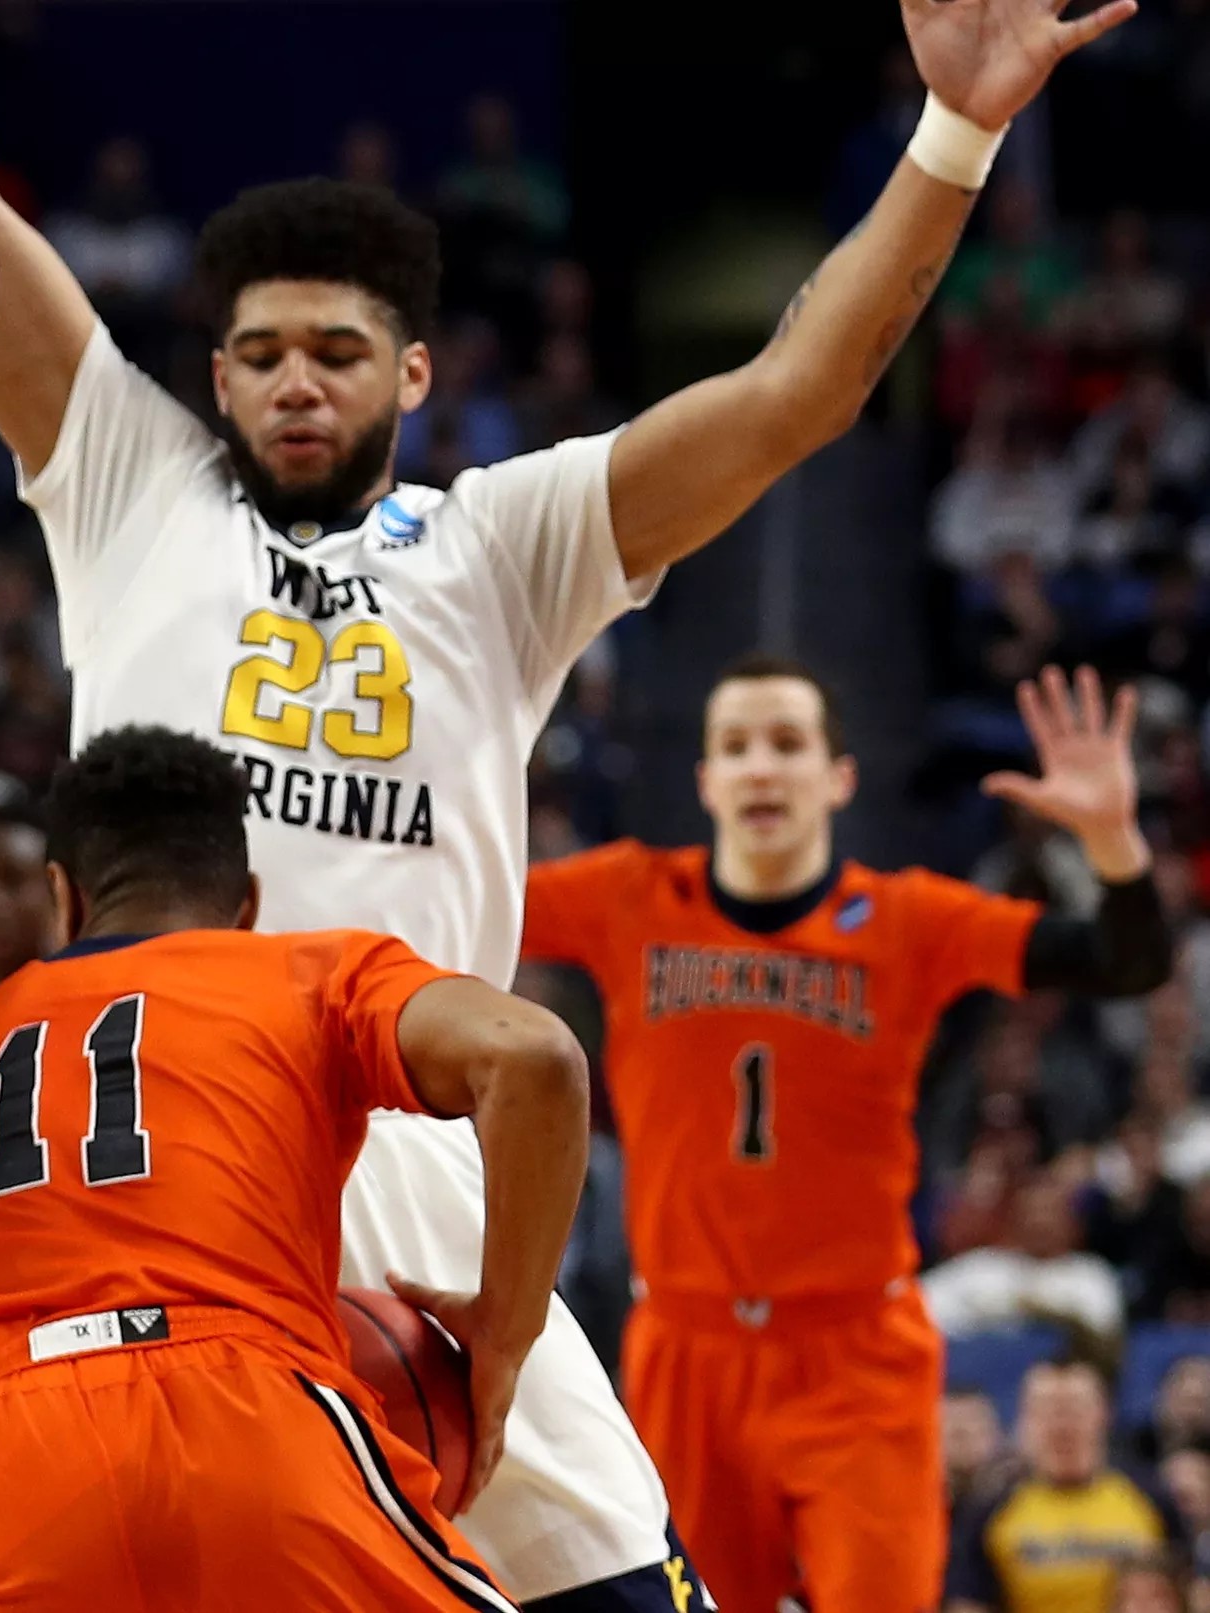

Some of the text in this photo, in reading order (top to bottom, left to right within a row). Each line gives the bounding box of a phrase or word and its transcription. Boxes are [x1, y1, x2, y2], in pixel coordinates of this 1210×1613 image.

[220, 608, 413, 761] 23
[222, 751, 434, 846] RGINIA
[732, 1045, 774, 1163] 1
